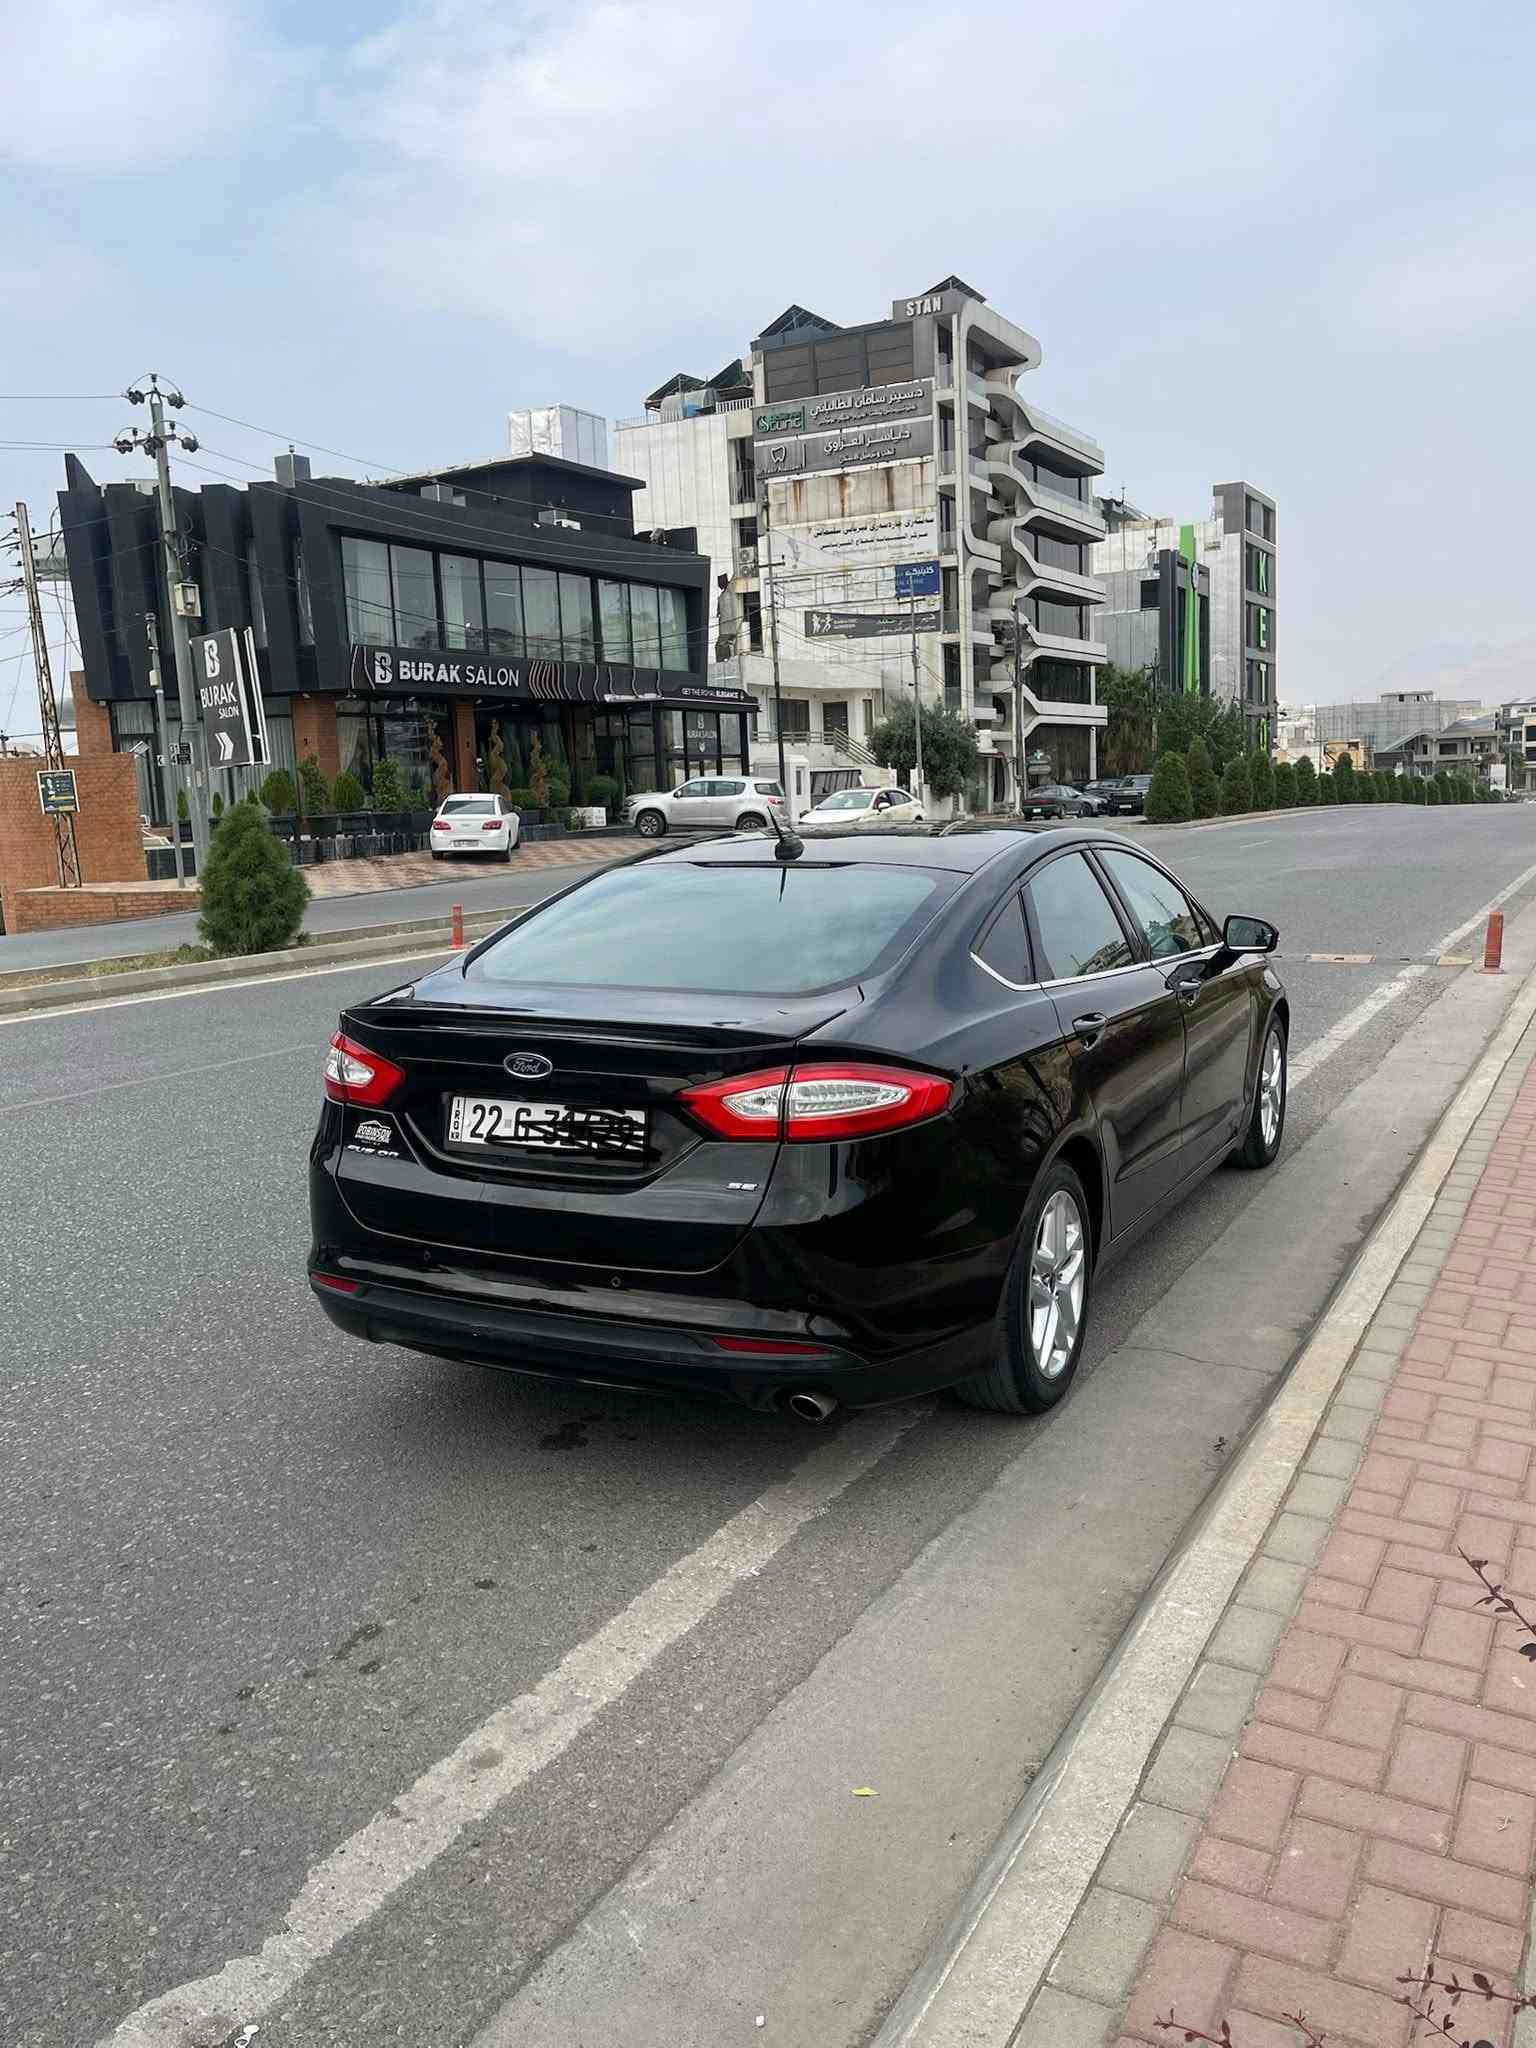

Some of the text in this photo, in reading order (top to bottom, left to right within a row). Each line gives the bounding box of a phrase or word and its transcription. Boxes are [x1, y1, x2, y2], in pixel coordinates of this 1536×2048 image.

[399, 660, 461, 684] BURAK
[465, 665, 519, 687] SALON
[200, 681, 237, 708] BURAK
[219, 706, 240, 719] SALON
[512, 1056, 541, 1074] Ford
